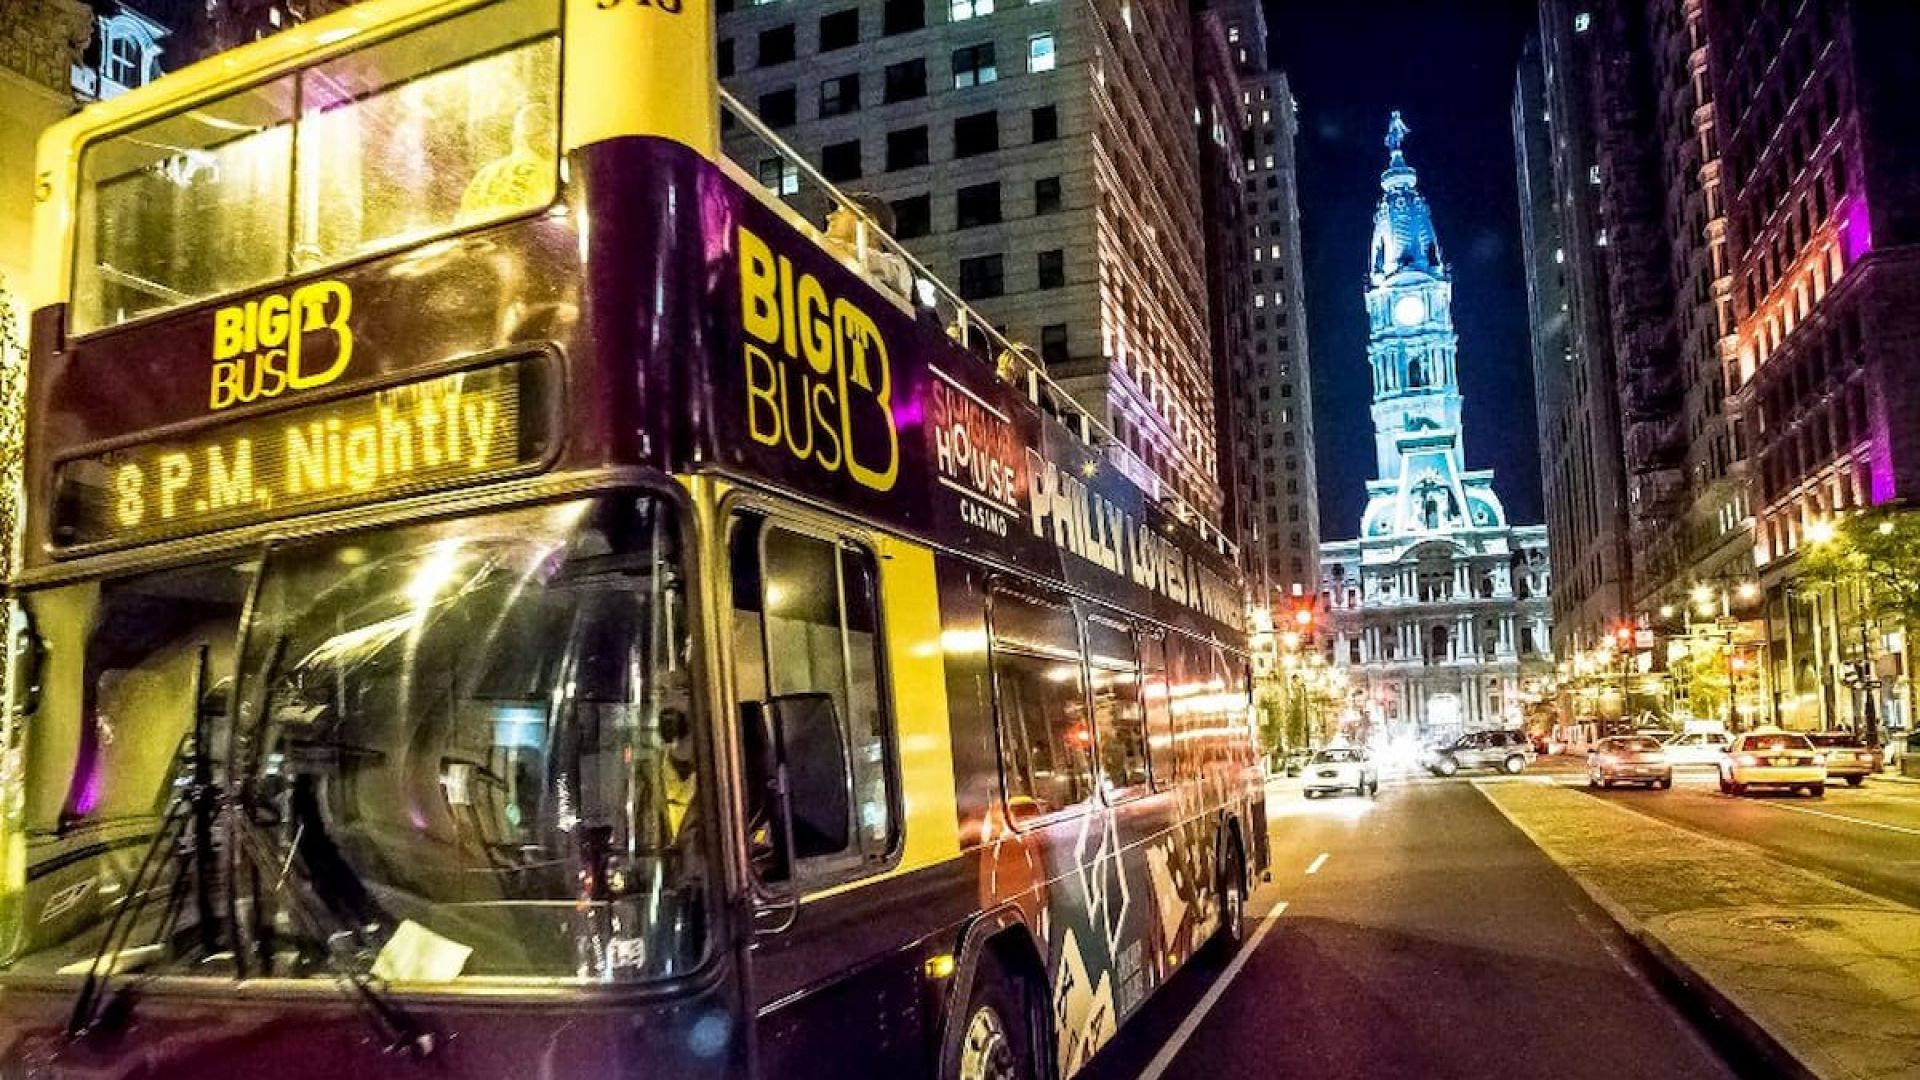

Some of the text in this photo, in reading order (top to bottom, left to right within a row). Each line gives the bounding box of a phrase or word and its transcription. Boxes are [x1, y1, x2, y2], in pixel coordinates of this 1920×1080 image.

[213, 294, 289, 360] BIG
[738, 225, 832, 374] BIG
[210, 348, 287, 410] BUS
[744, 342, 841, 471] BUS
[116, 463, 144, 527] 8
[284, 391, 498, 492] Nightly
[935, 425, 1018, 507] HOUSE
[1026, 446, 1124, 576] PHILLY
[960, 499, 1007, 538] CASINO
